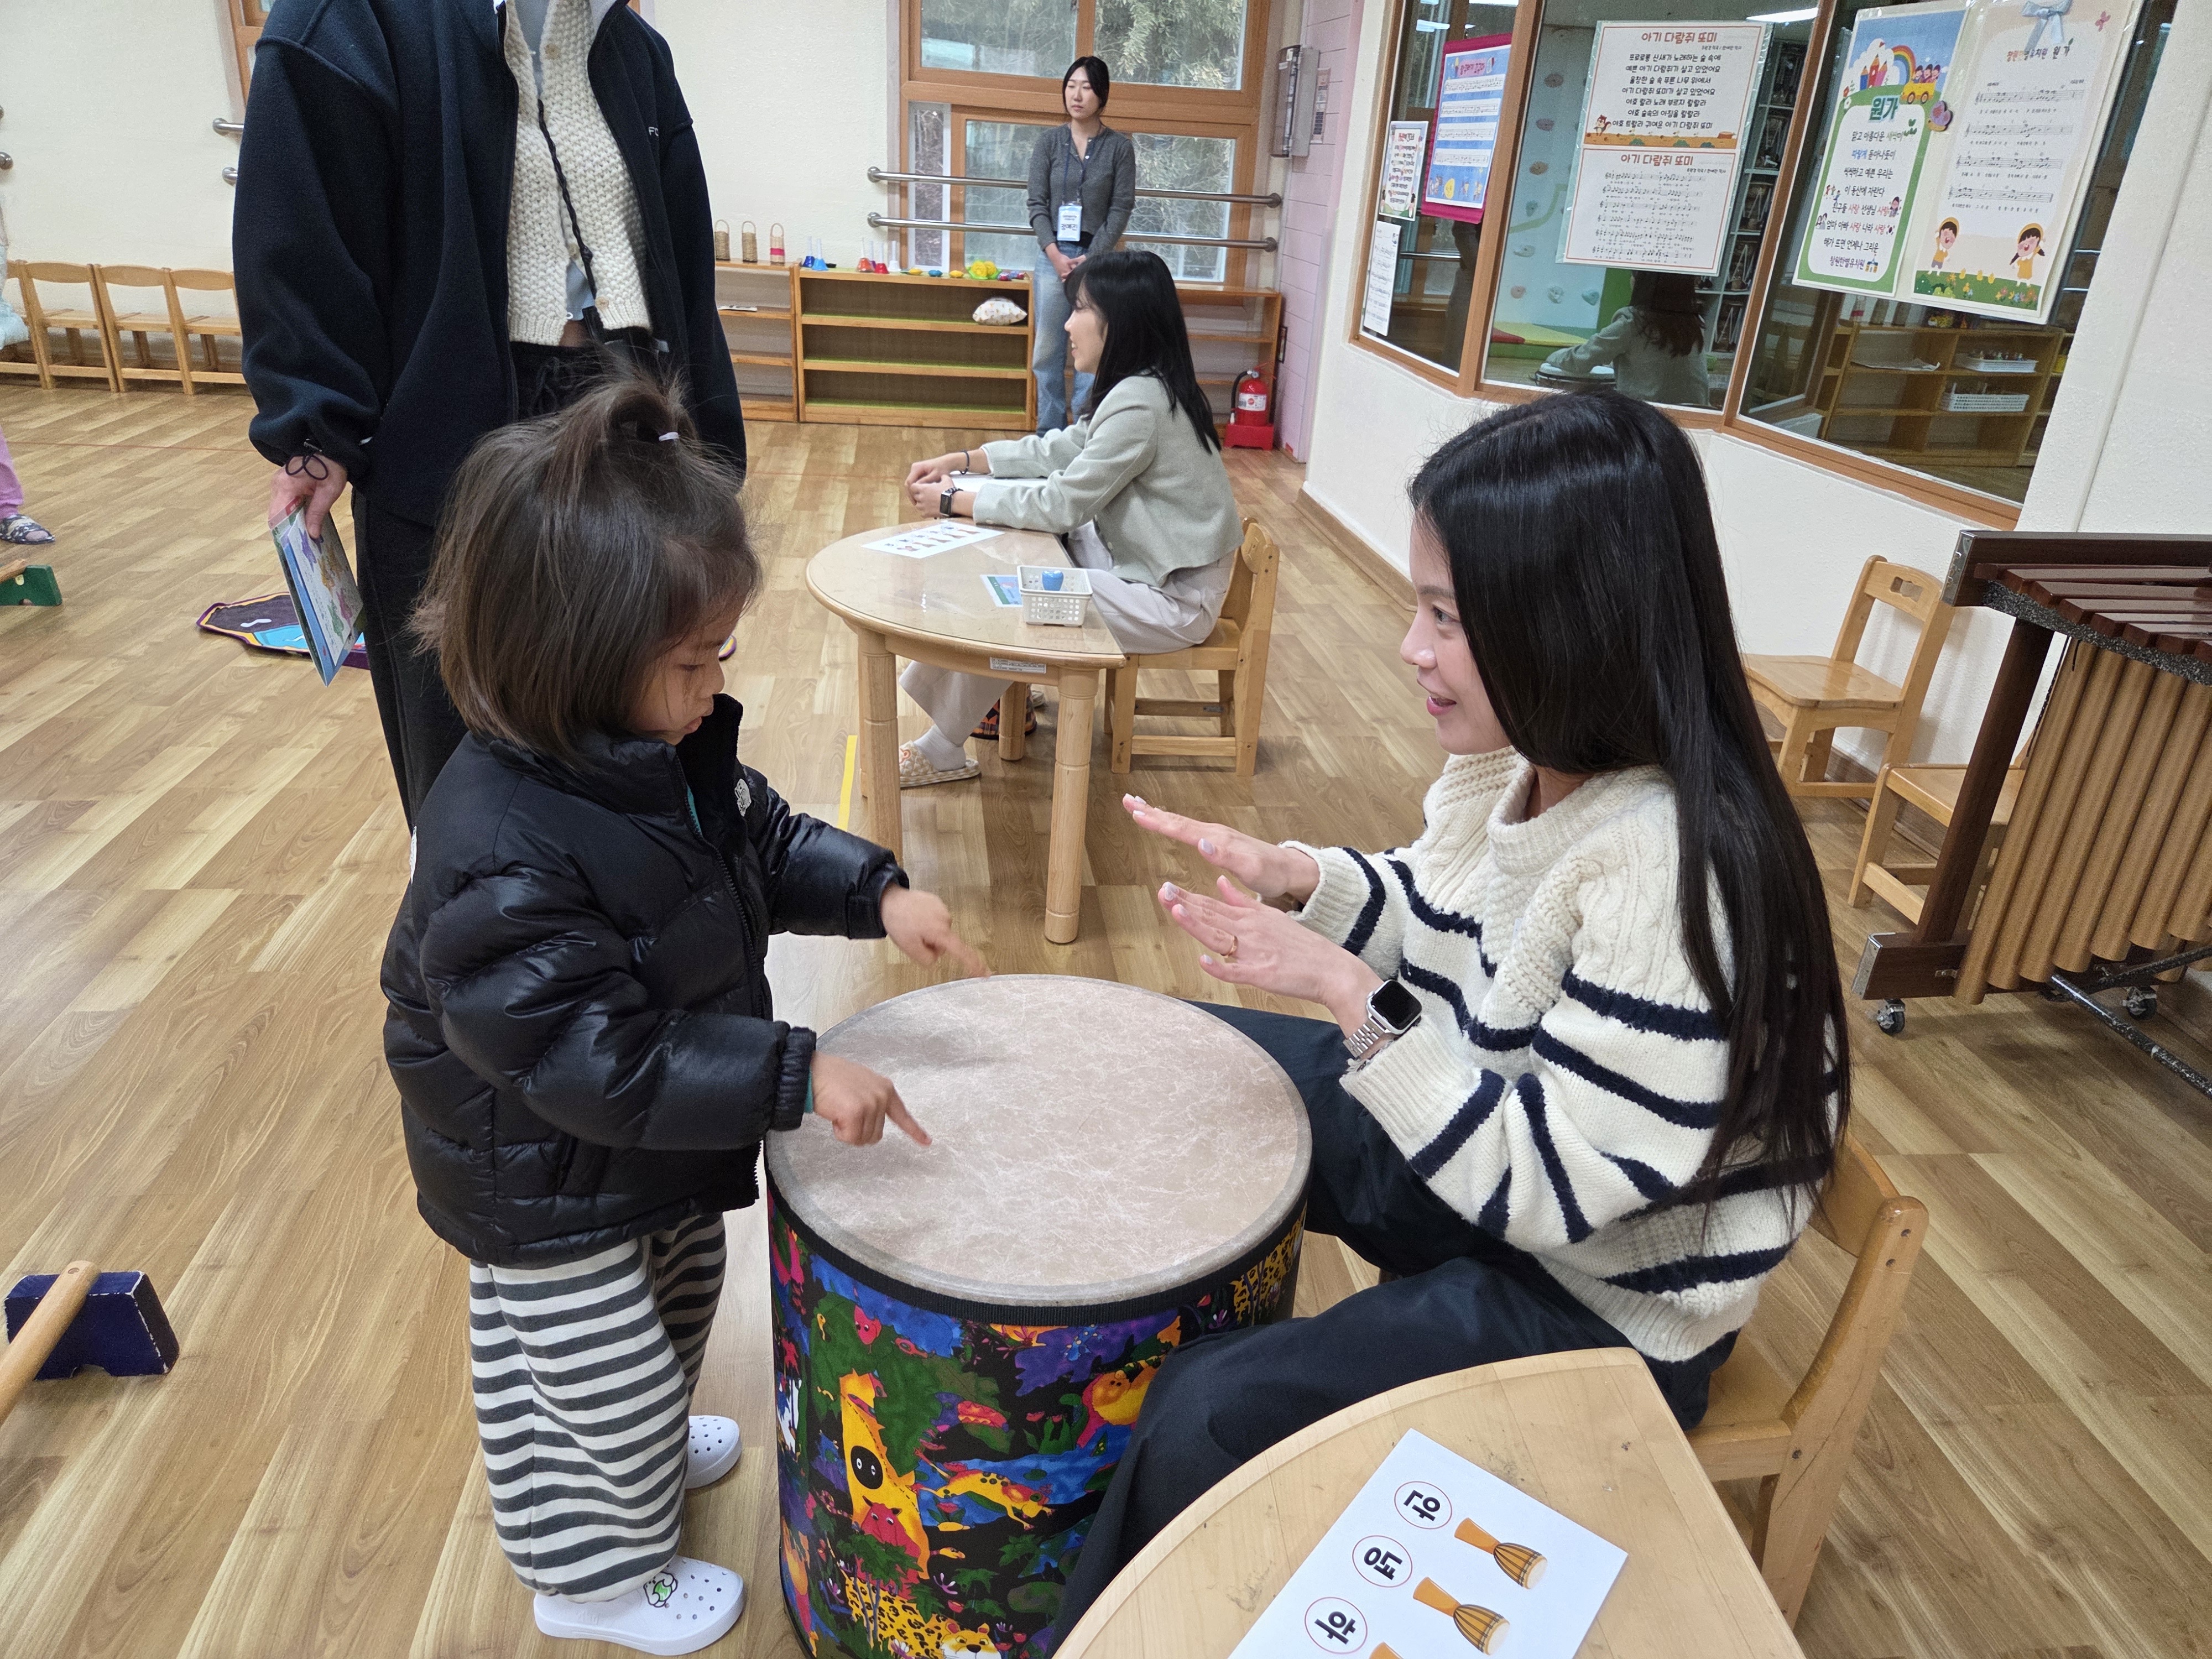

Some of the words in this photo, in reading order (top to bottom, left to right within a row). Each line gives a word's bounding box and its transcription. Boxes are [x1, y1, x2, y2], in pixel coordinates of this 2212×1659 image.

[1641, 32, 1662, 42] 아기
[1664, 32, 1695, 44] 다람쥐
[1698, 32, 1717, 43] 또미
[1869, 98, 1898, 121] 원가
[1851, 131, 1863, 142] 맑고
[1864, 131, 1885, 142] 아름다운
[1621, 154, 1640, 164] 아기
[1643, 154, 1672, 166] 다람쥐
[1674, 155, 1693, 165] 또미
[1865, 168, 1876, 178] 예쁜
[1877, 168, 1893, 179] 우리는
[1845, 185, 1850, 195] 이
[1851, 186, 1867, 196] 동산에
[1867, 186, 1885, 197] 자란다
[1833, 202, 1848, 213] 친구들
[1849, 204, 1860, 215] 사랑
[1861, 205, 1877, 216] 선생님
[1877, 206, 1890, 217] 사랑
[1827, 220, 1837, 230] 엄마
[1838, 221, 1849, 231] 아빠
[1849, 222, 1861, 232] 사랑
[1863, 222, 1874, 233] 나라
[1874, 223, 1886, 235] 사랑
[1824, 237, 1834, 247] 해가
[1835, 239, 1846, 249] 뜨면
[1847, 240, 1863, 251] 언제나
[1863, 242, 1879, 253] 그리운
[1403, 1489, 1441, 1521] 안
[1364, 1547, 1402, 1580] 녕
[1314, 1611, 1356, 1645] 하
